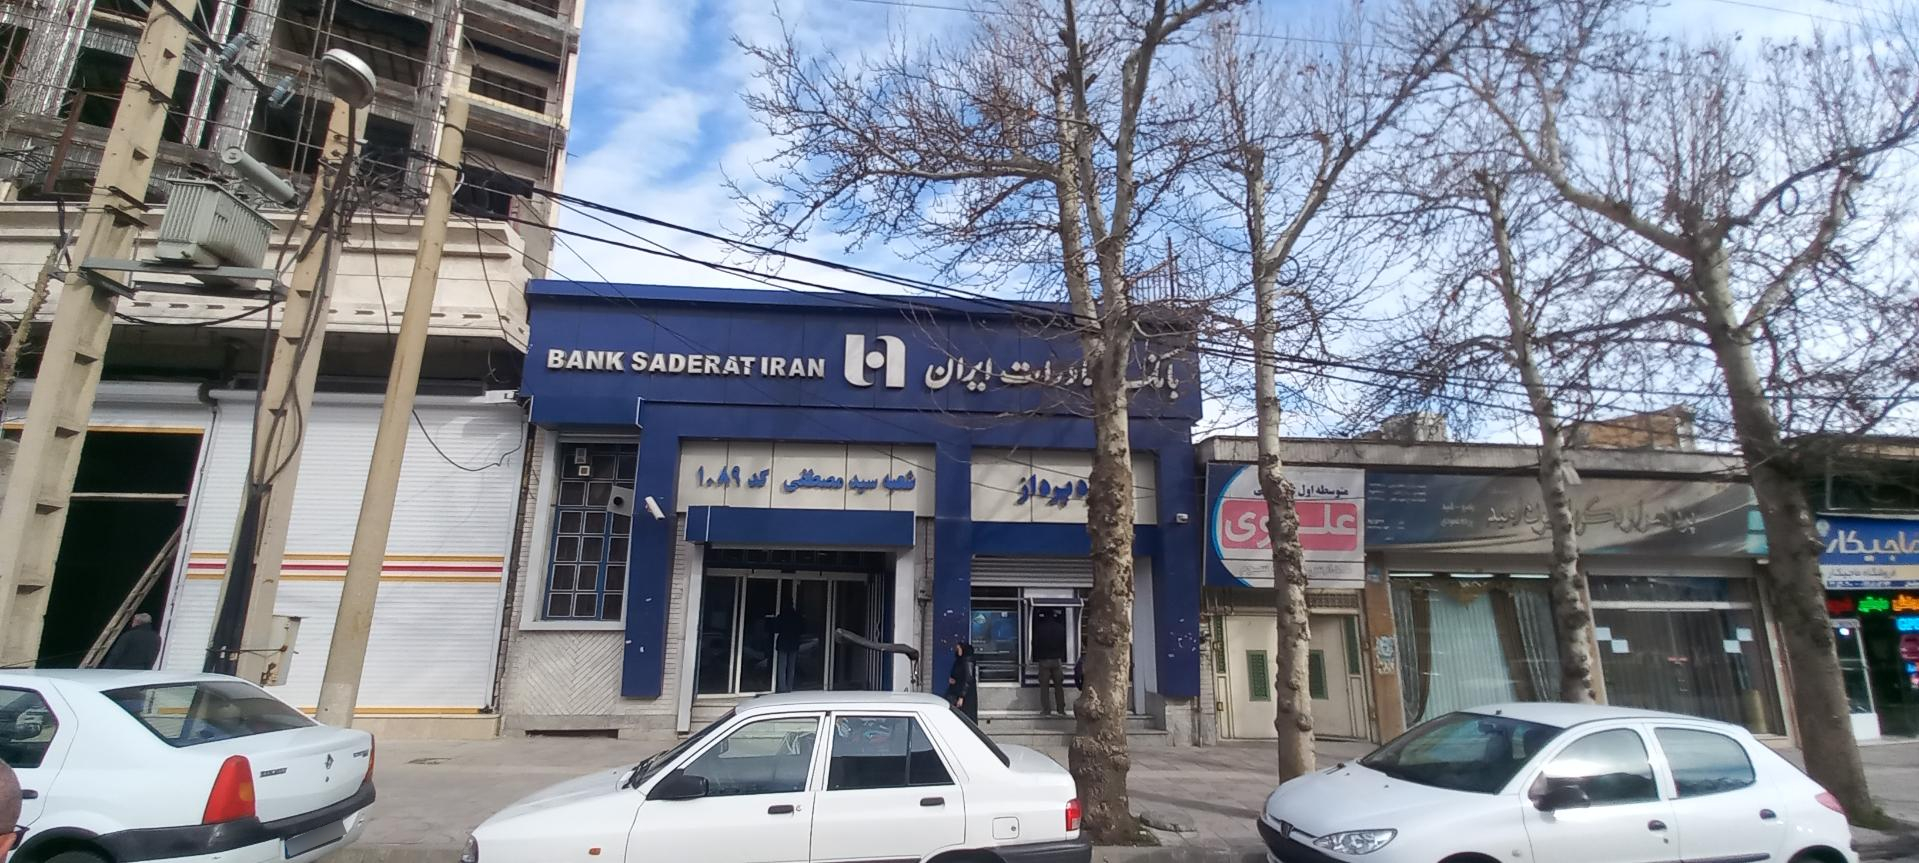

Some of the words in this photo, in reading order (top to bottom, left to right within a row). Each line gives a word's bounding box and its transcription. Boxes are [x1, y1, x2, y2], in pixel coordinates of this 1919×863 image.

[547, 349, 625, 372] BANK
[631, 351, 756, 376] SADERAT
[760, 356, 826, 379] IRAN
[924, 357, 993, 392] ایران
[1001, 359, 1093, 388] ادرات
[746, 468, 770, 489] کد
[783, 468, 844, 493] مصطفی
[848, 474, 879, 494] سید
[882, 469, 917, 493] شعبه
[1297, 484, 1314, 498] اول
[1315, 484, 1349, 498] متوسطه
